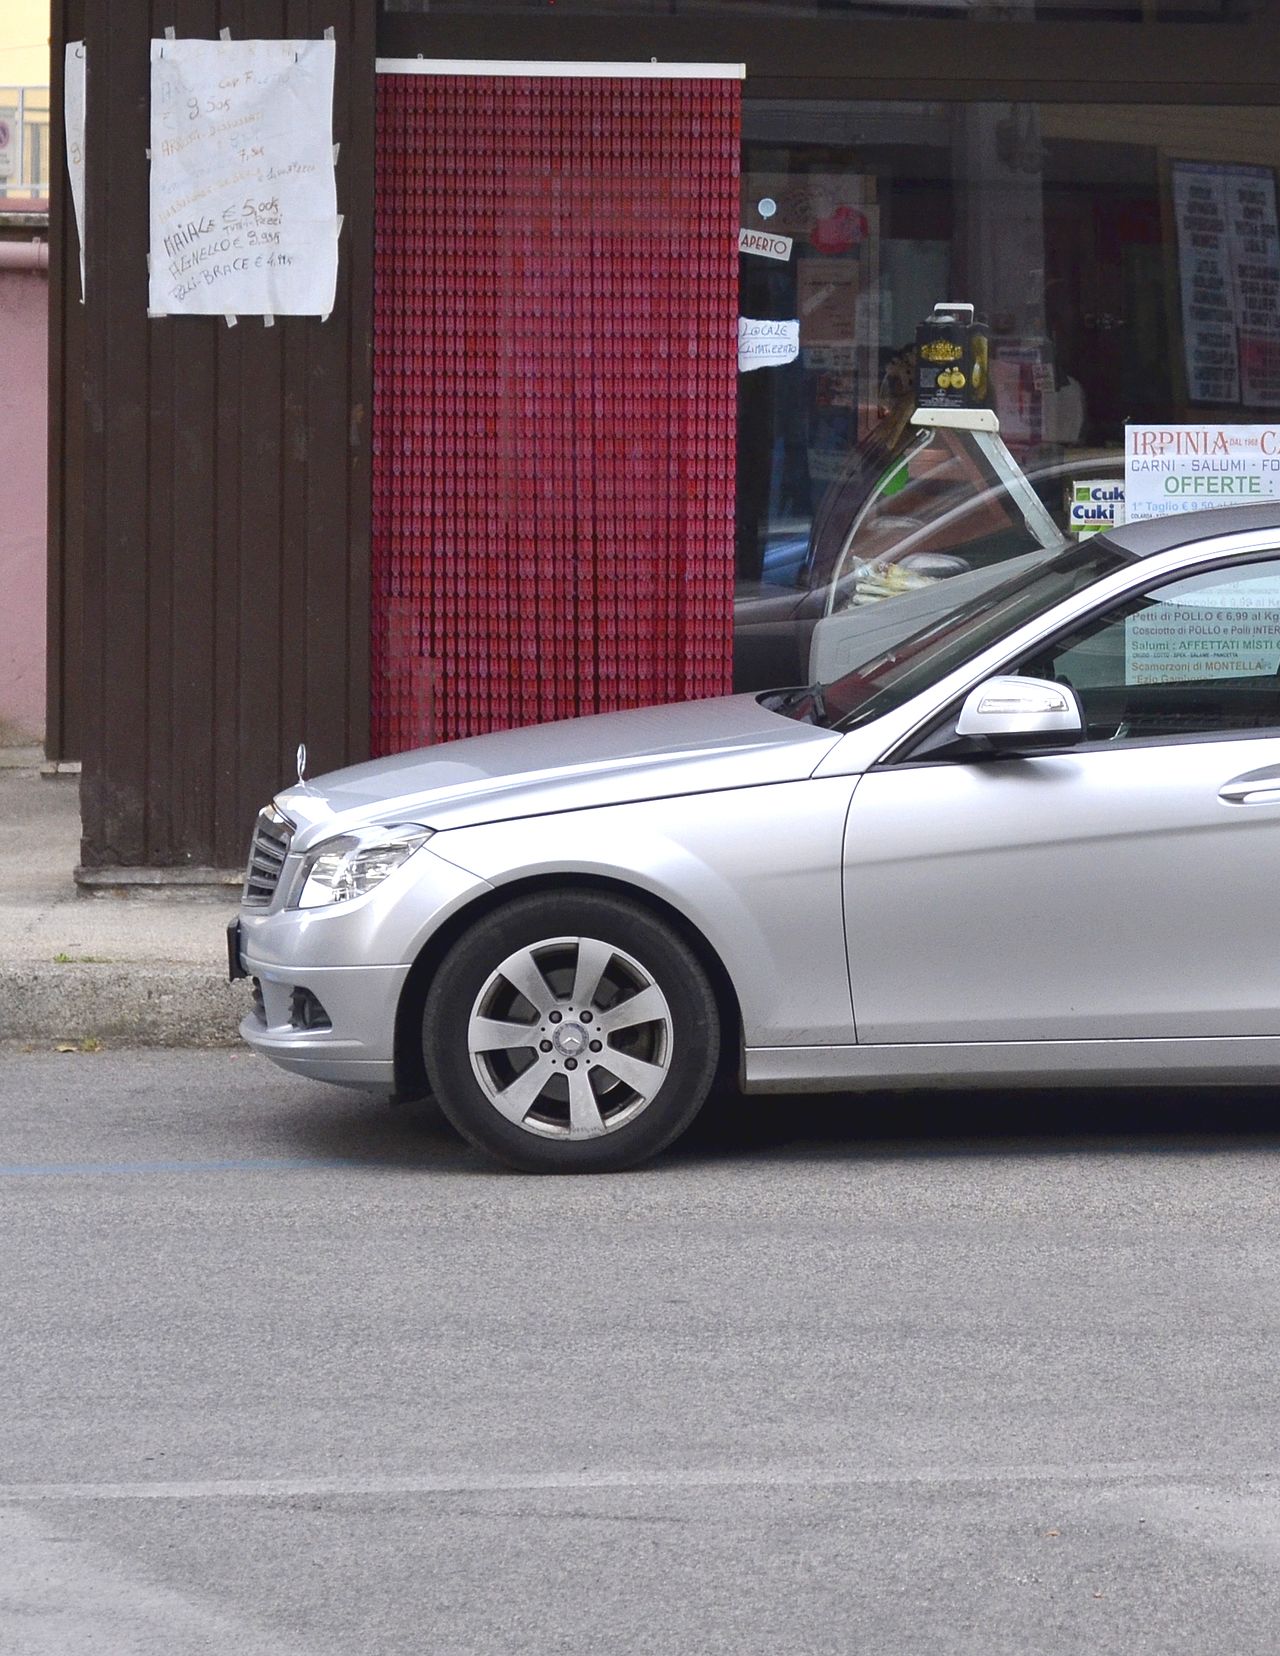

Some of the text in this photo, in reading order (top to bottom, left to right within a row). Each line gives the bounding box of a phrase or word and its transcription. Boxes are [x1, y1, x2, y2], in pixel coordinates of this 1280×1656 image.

[741, 234, 787, 254] APERTO
[1132, 431, 1230, 457] IRPINIA
[1131, 459, 1175, 472] CARNI
[1191, 459, 1246, 472] SALUMI
[1164, 475, 1261, 493] OFFERTE
[1091, 487, 1125, 500] Cuk
[1072, 504, 1114, 519] Cuki
[1146, 501, 1179, 512] Taglio
[1181, 502, 1189, 511] €
[1132, 612, 1157, 621] Petti
[1161, 612, 1170, 621] di
[1174, 612, 1212, 621] POLLO
[1216, 612, 1223, 621] €
[1252, 612, 1260, 621] al
[1132, 626, 1175, 635] Cosciotto
[1177, 626, 1186, 635] di
[1189, 626, 1220, 635] POLLO
[1231, 626, 1251, 635] Polli
[1132, 641, 1169, 650] Salumi
[1179, 640, 1240, 649] AFFETTATI
[1243, 640, 1273, 649] MISTI
[1193, 661, 1202, 670] di
[1205, 661, 1262, 670] MONTELLA
